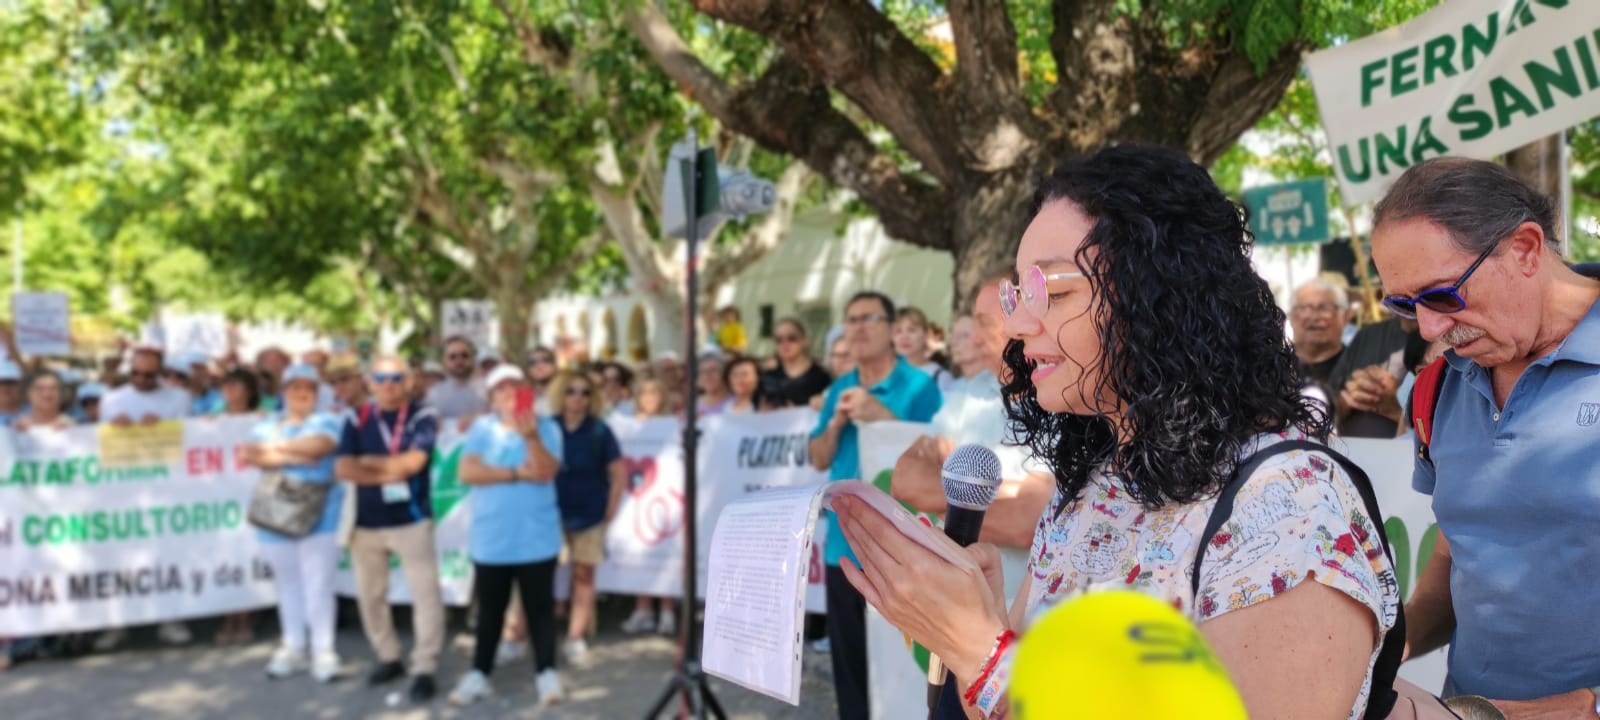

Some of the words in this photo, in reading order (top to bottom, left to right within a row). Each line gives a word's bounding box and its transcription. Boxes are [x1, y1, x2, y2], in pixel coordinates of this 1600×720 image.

[1361, 0, 1569, 107] FERNA
[1337, 116, 1448, 184] UNA
[1447, 28, 1600, 142] SANI
[187, 446, 225, 475] EN
[22, 500, 242, 548] CONSULTORIO
[191, 568, 206, 594] y
